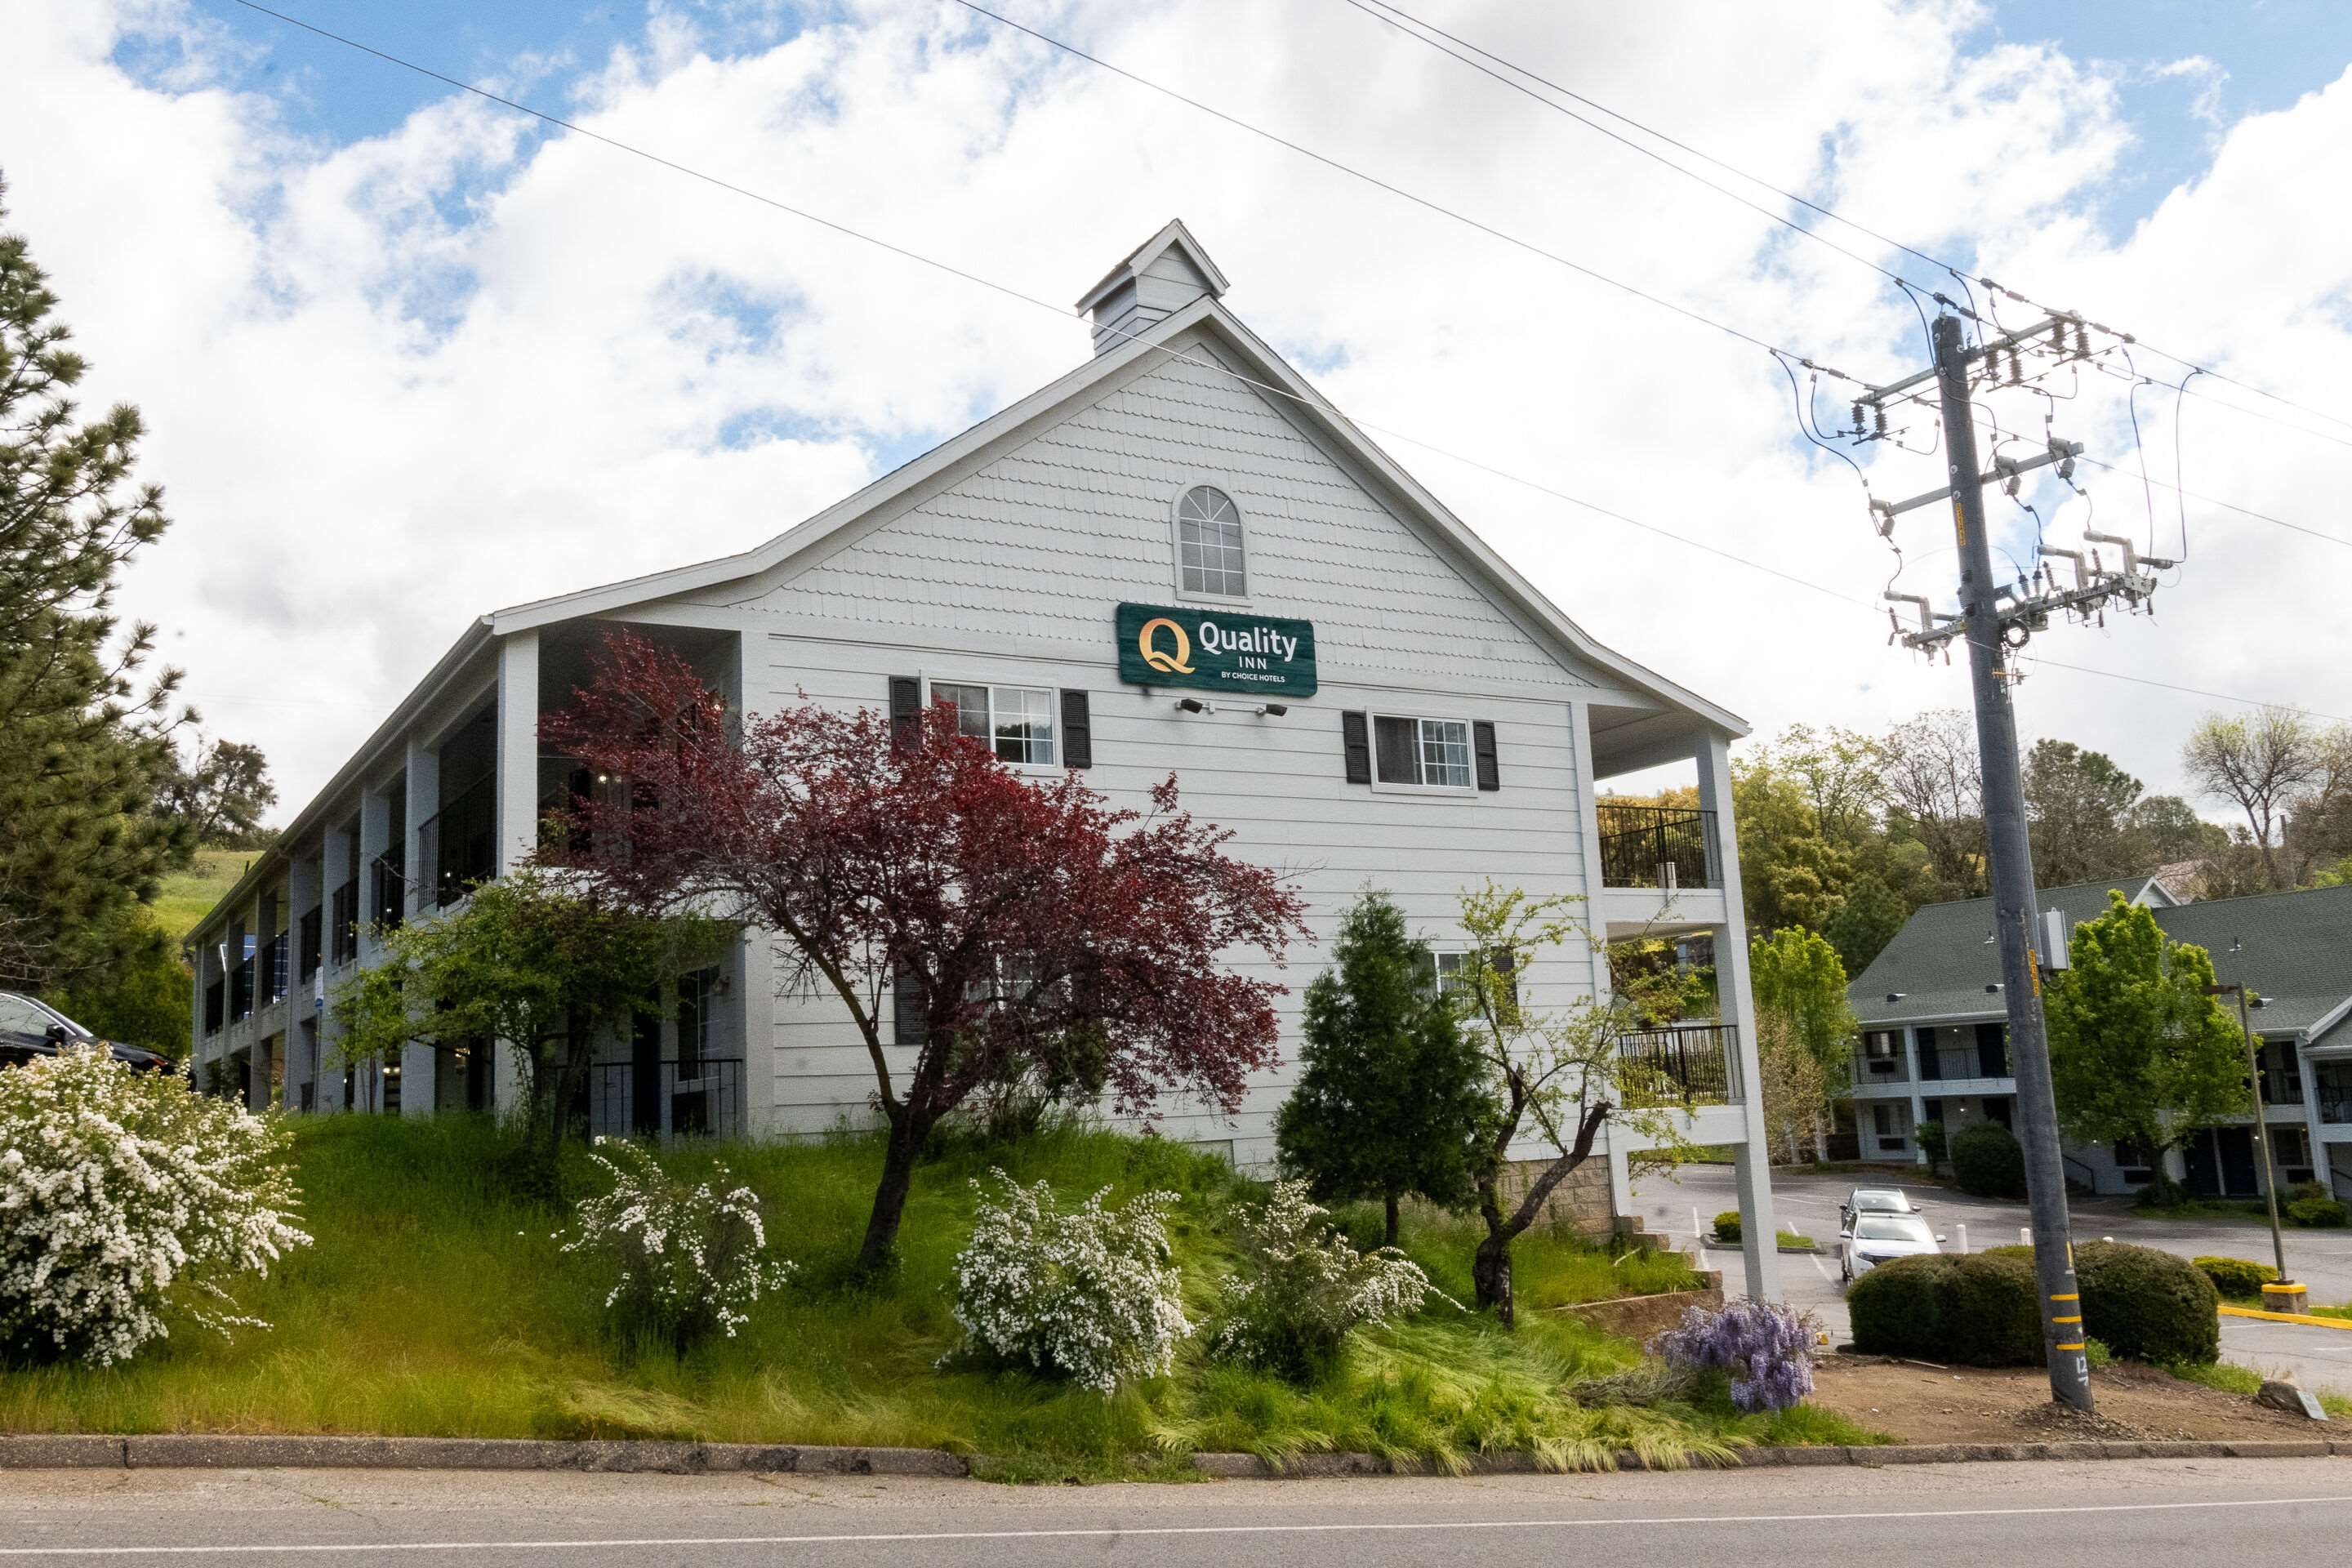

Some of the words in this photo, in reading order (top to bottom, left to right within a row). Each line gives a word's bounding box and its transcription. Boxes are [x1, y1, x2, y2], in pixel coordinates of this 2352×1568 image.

[1139, 618, 1196, 674] Q
[1199, 621, 1297, 662] Quality
[1239, 656, 1267, 670] INN
[1232, 672, 1258, 680] CHOICE
[1259, 674, 1285, 683] HOTELS
